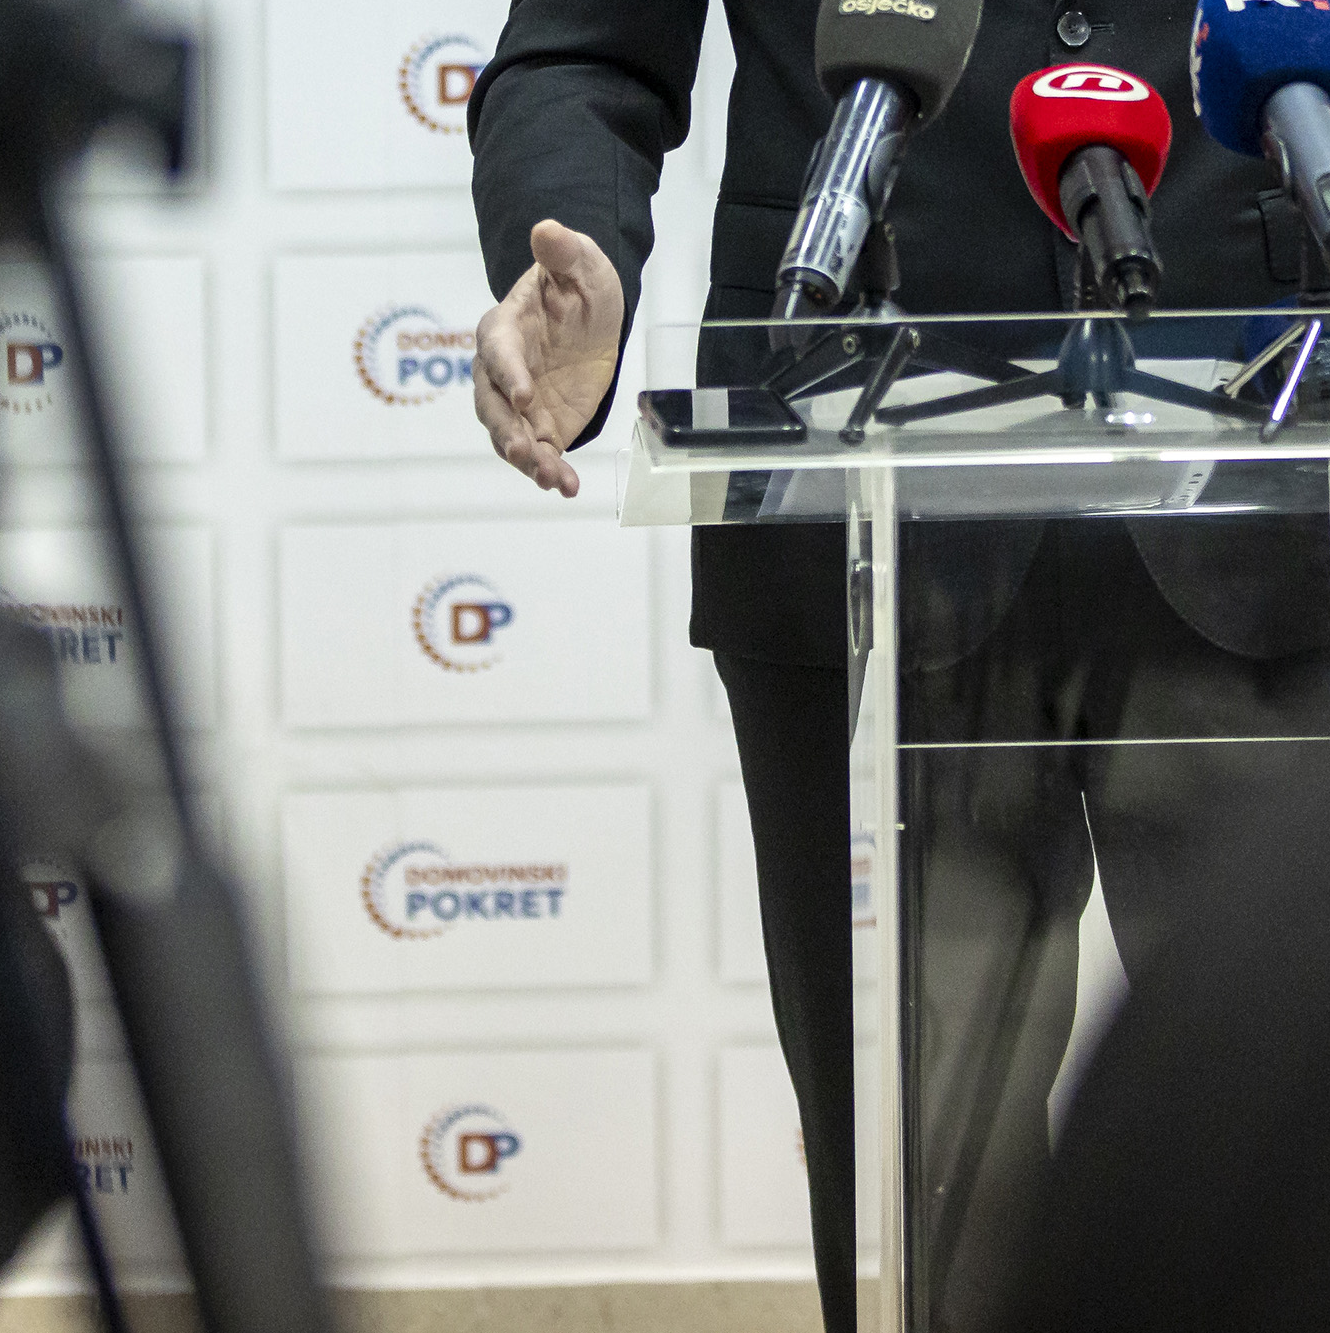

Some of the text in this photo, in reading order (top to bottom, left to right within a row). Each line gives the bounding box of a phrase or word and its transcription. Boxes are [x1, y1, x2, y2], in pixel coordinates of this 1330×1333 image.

[7, 342, 63, 385] DP
[449, 602, 514, 645] DP
[405, 864, 567, 886] DOMOVINSKI
[405, 888, 564, 921] POKRET
[457, 1132, 523, 1175] DP
